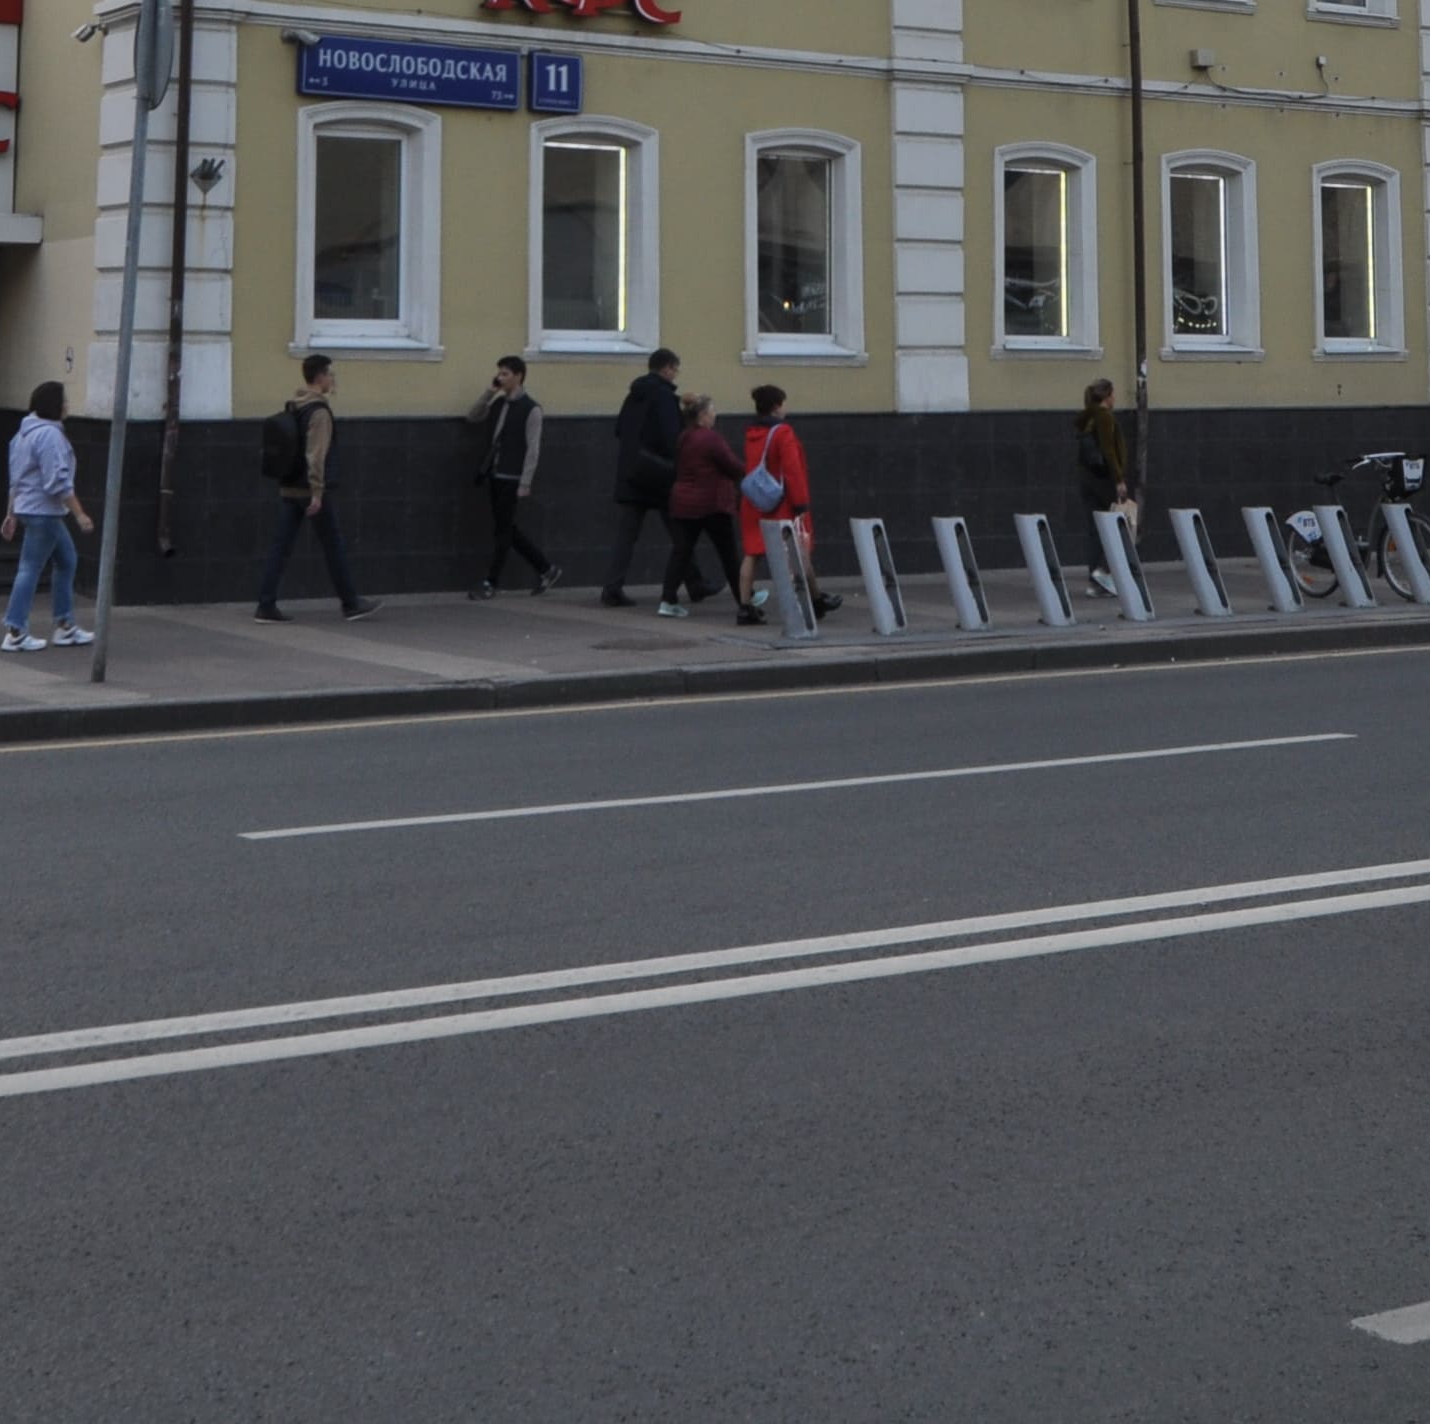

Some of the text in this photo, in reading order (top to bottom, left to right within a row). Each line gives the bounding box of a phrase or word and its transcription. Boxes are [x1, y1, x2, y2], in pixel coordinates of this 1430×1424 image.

[319, 48, 508, 83] НОВОСЛОБОДСКАЯ
[545, 63, 569, 92] 11
[390, 77, 437, 92] УЛИЦА
